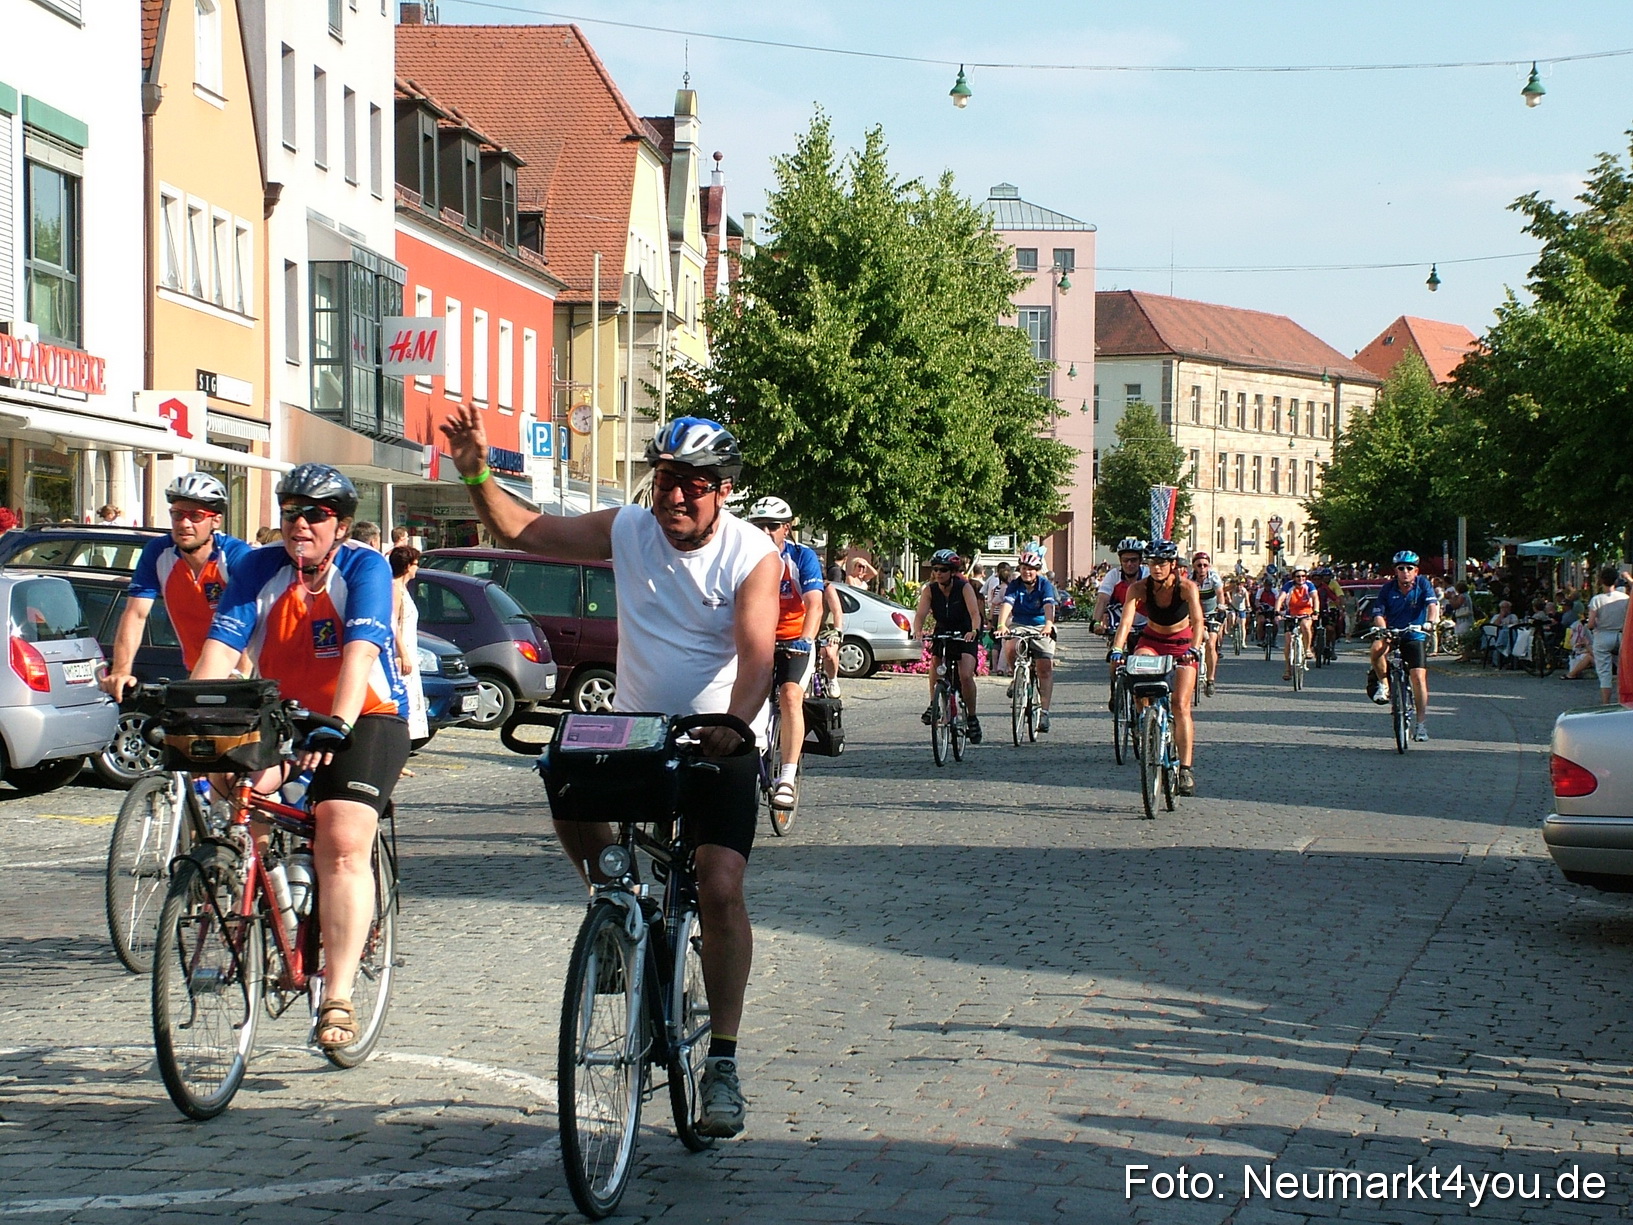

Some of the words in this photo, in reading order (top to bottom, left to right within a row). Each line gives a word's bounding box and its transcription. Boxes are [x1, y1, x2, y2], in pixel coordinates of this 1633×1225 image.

[388, 329, 438, 363] H&M
[0, 332, 106, 395] EN-APOTHEKE
[535, 426, 549, 453] P
